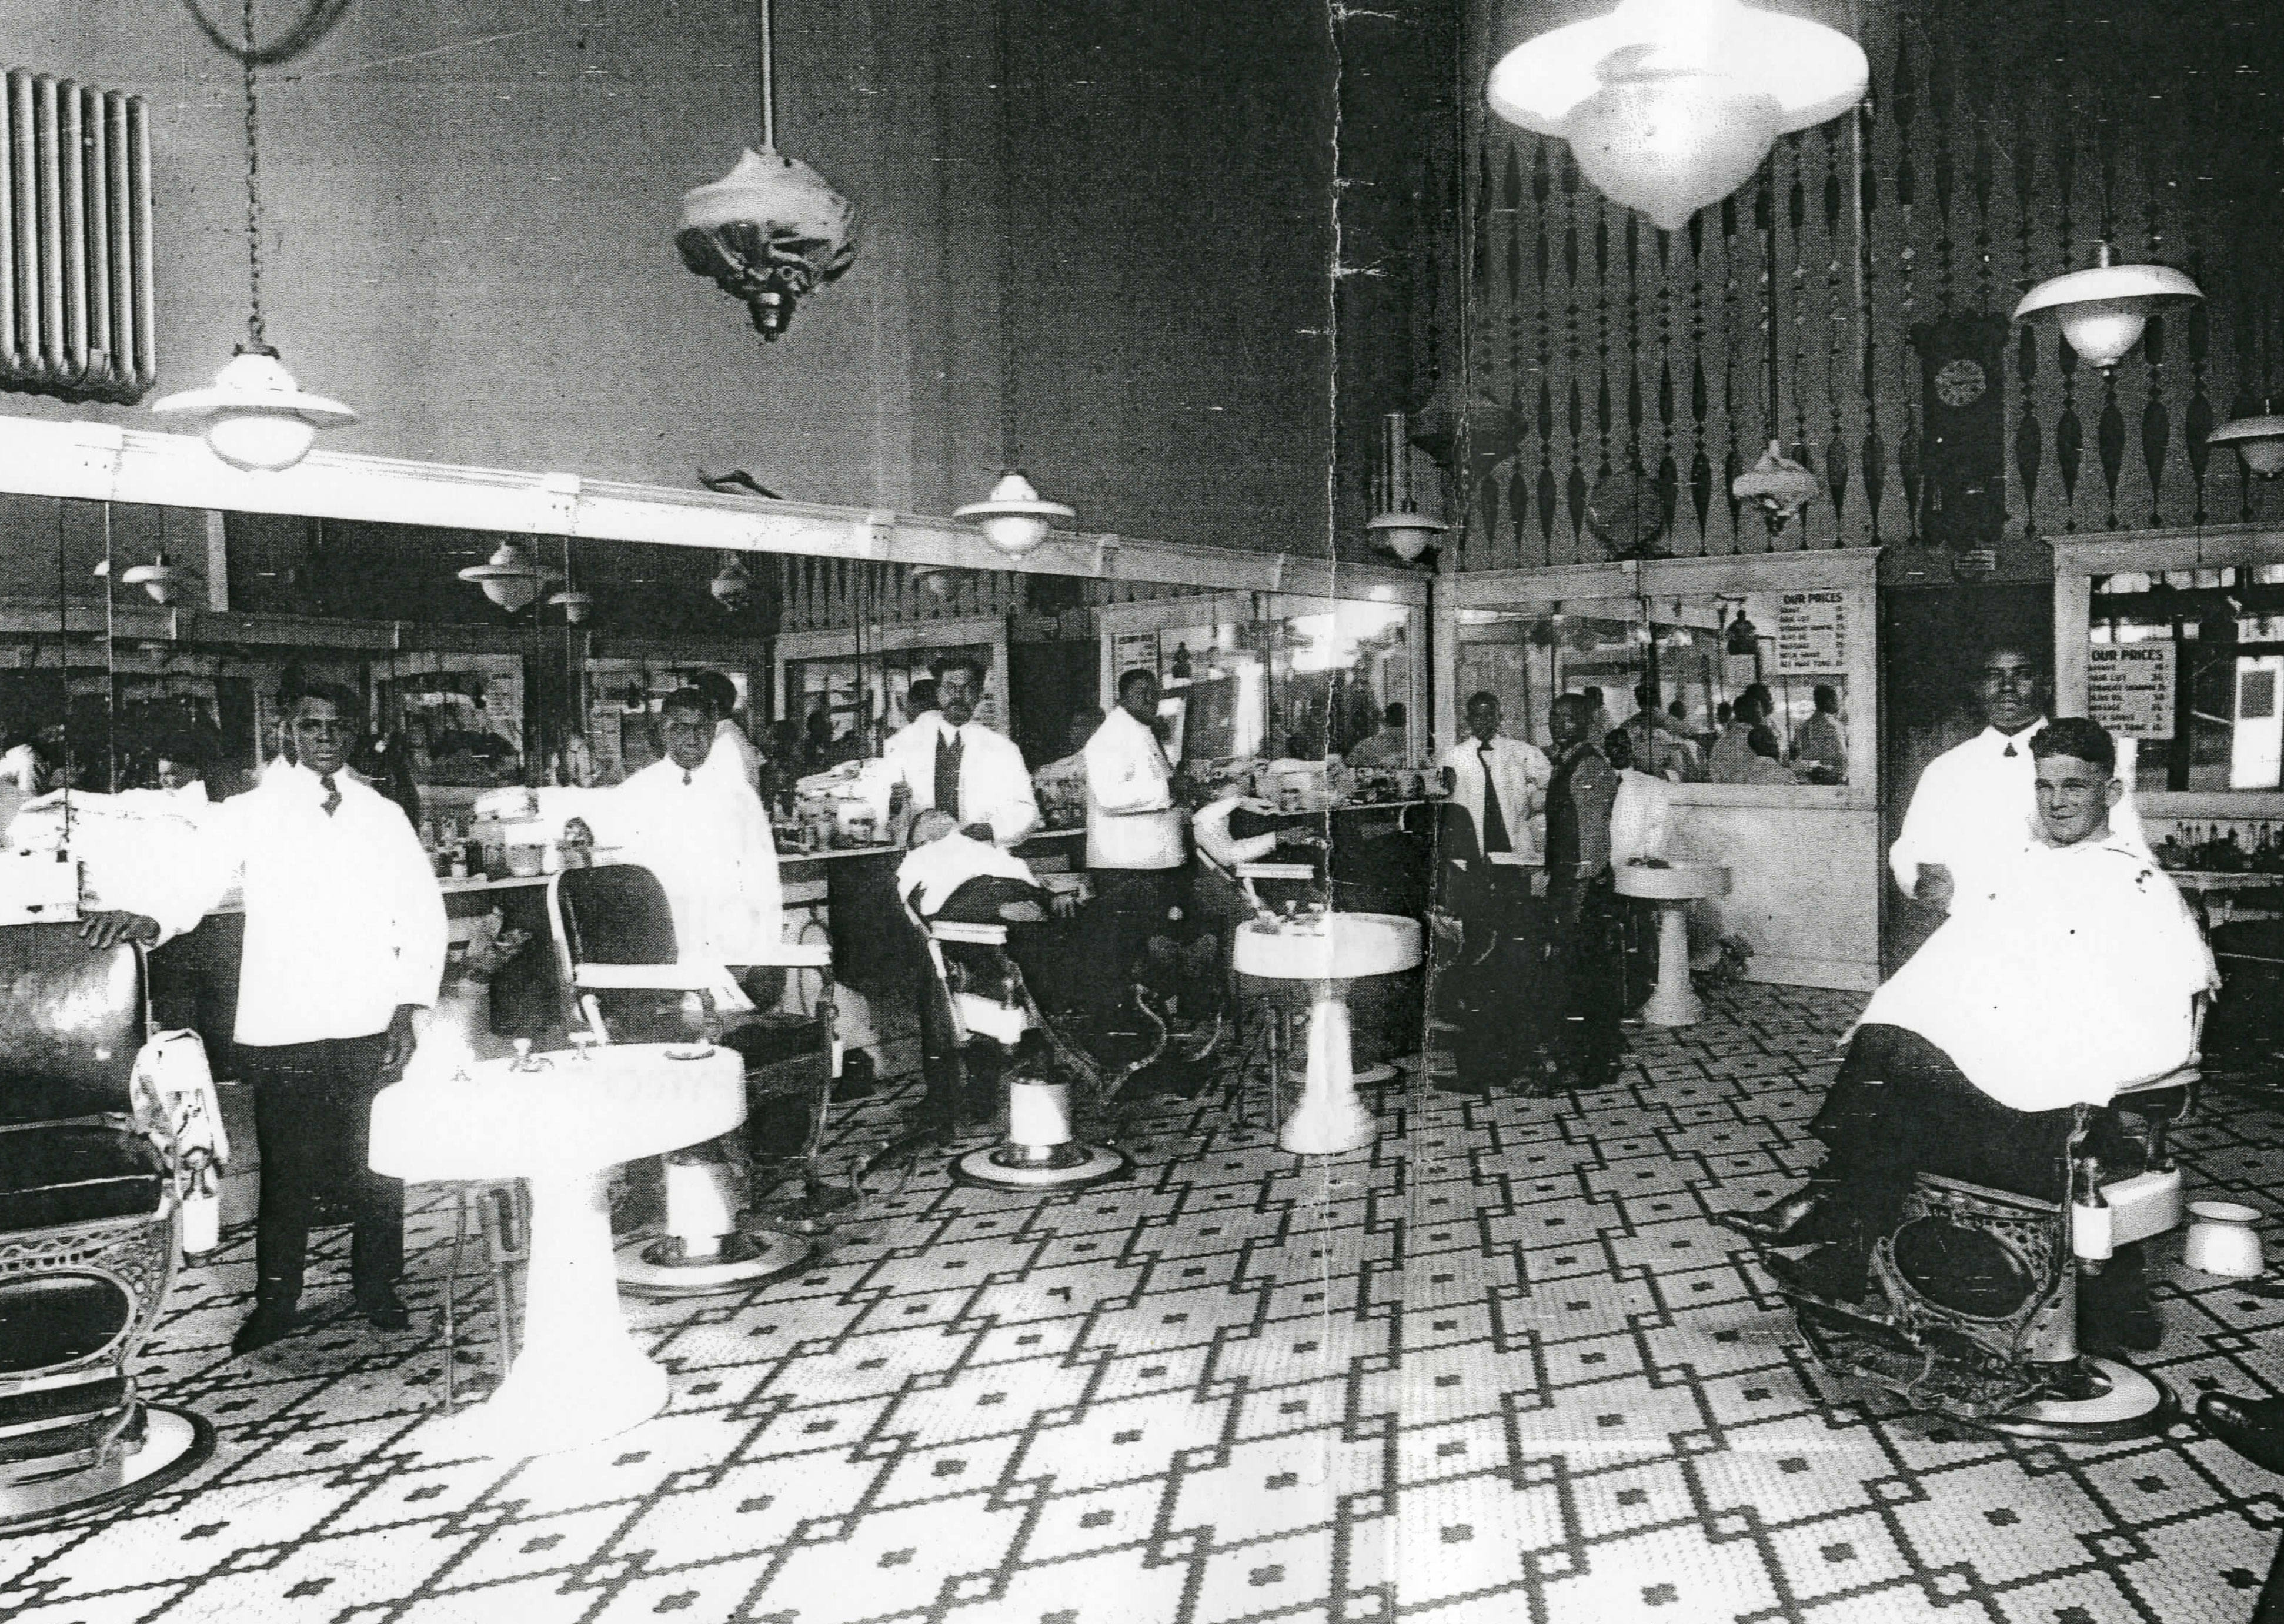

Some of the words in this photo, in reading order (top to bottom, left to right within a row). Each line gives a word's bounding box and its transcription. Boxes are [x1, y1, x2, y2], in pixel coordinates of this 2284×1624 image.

[1784, 594, 1805, 605] OUR
[1808, 592, 1843, 603] PRICES
[2092, 649, 2117, 661] OUR
[2121, 649, 2164, 661] PRICES
